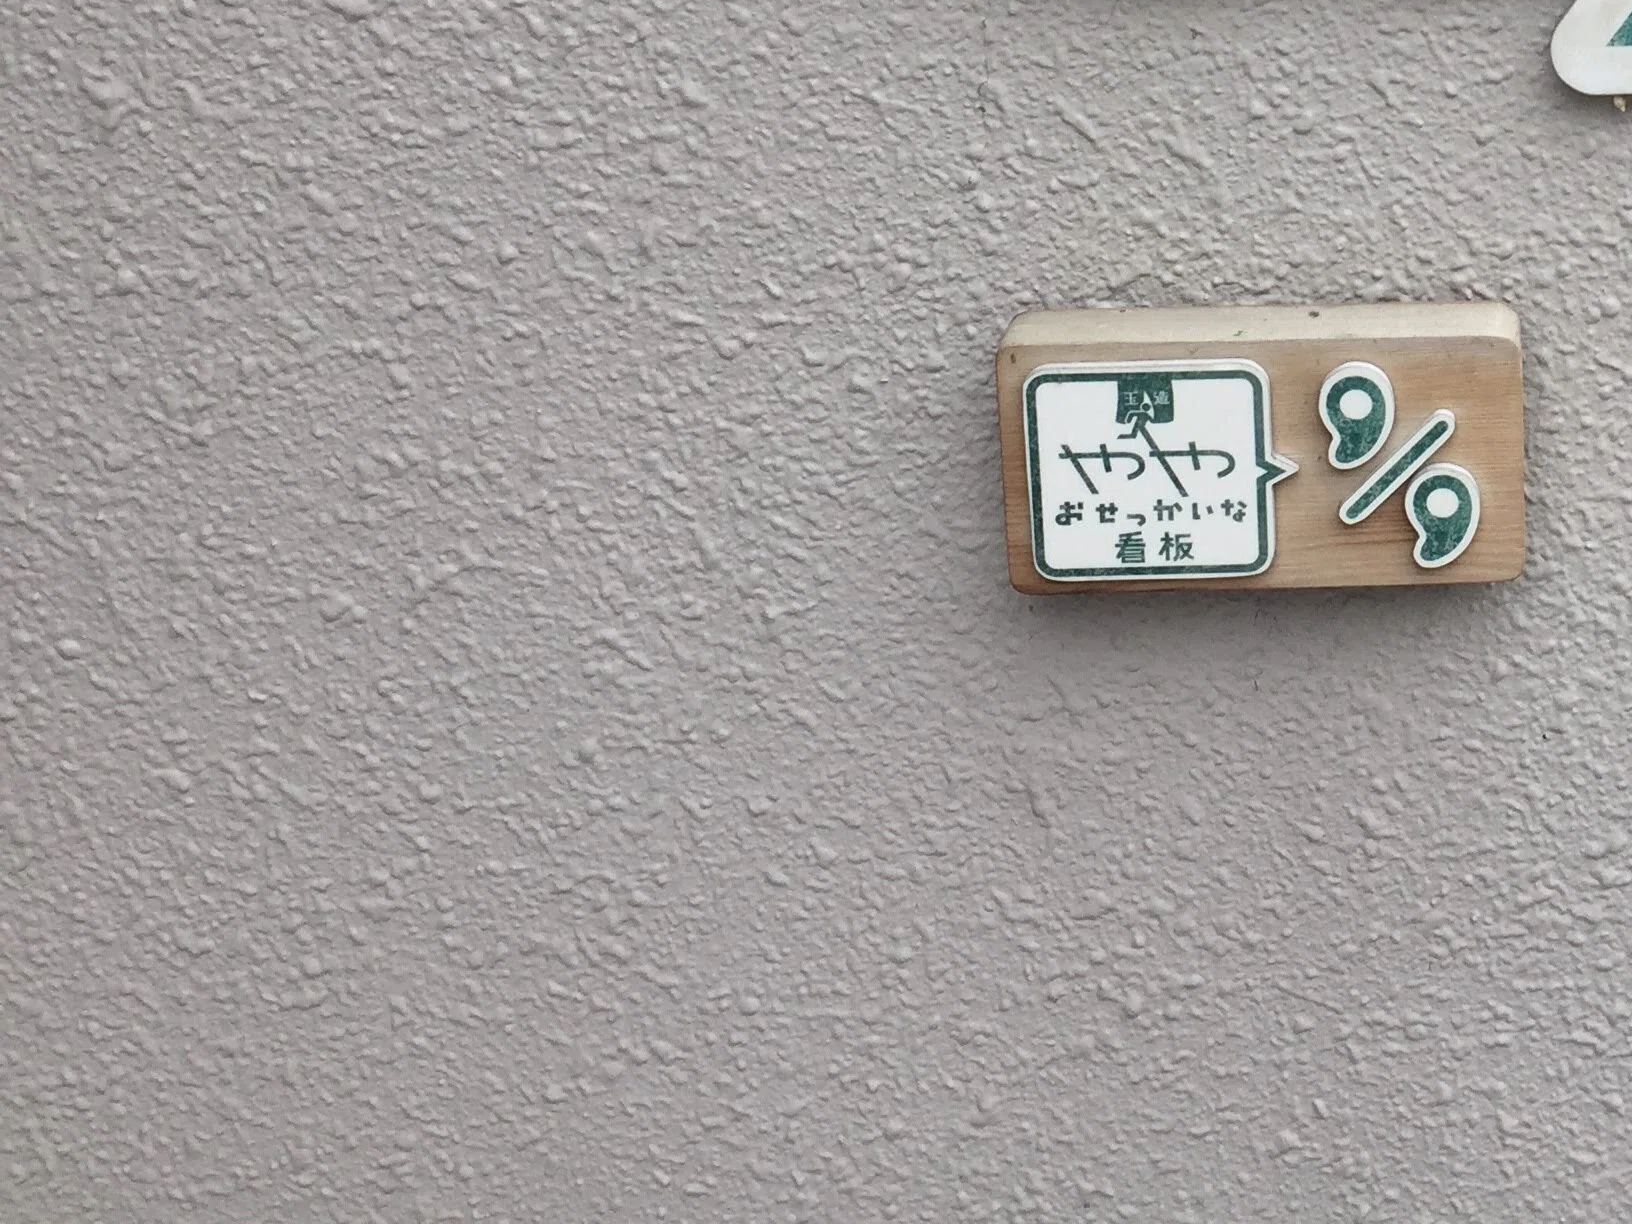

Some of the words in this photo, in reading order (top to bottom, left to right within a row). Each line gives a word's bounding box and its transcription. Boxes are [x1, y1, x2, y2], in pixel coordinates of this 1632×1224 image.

[1058, 426, 1236, 498] やや
[1054, 498, 1248, 527] おせっかいな
[1114, 531, 1196, 564] 看板
